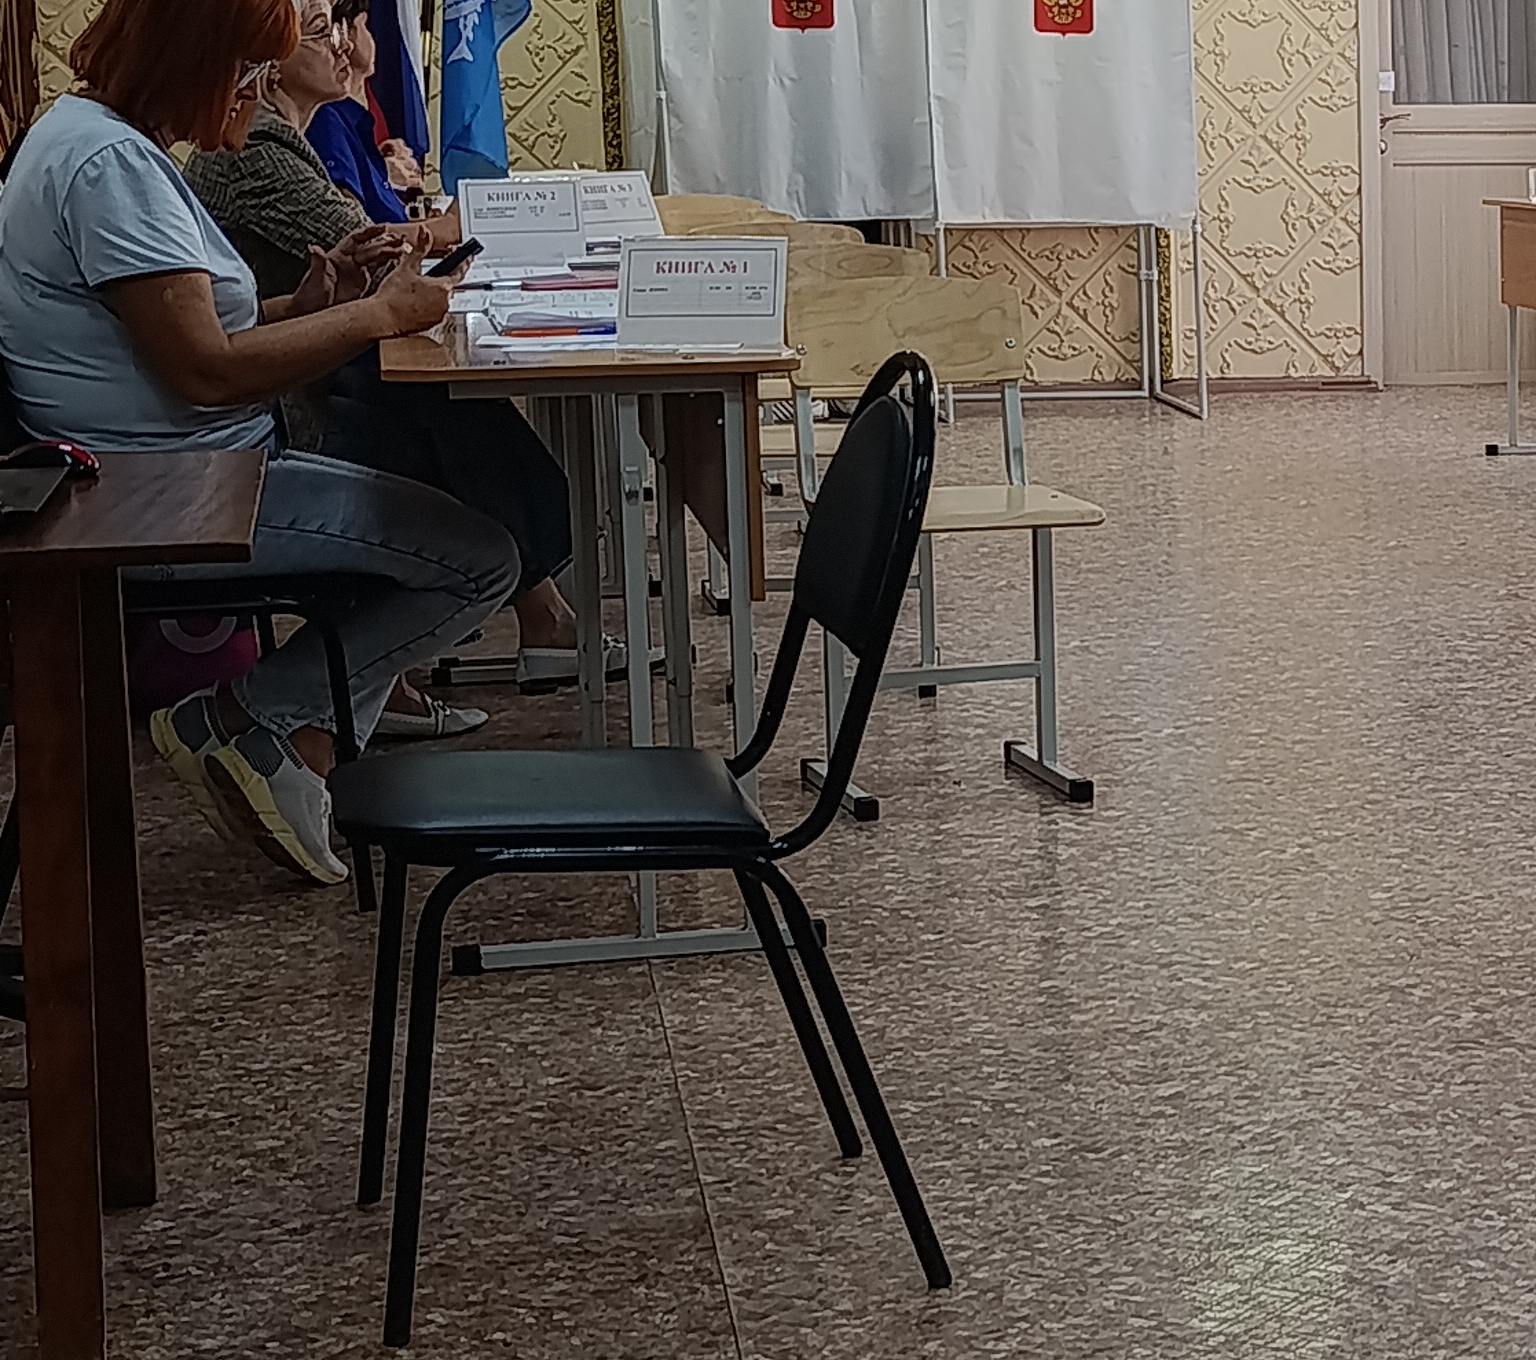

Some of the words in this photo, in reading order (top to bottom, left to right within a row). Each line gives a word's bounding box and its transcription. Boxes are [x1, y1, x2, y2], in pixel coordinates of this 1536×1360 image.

[487, 192, 531, 202] КНИГА
[550, 191, 556, 201] 2
[655, 261, 715, 274] КНИГА
[742, 261, 748, 274] 1
